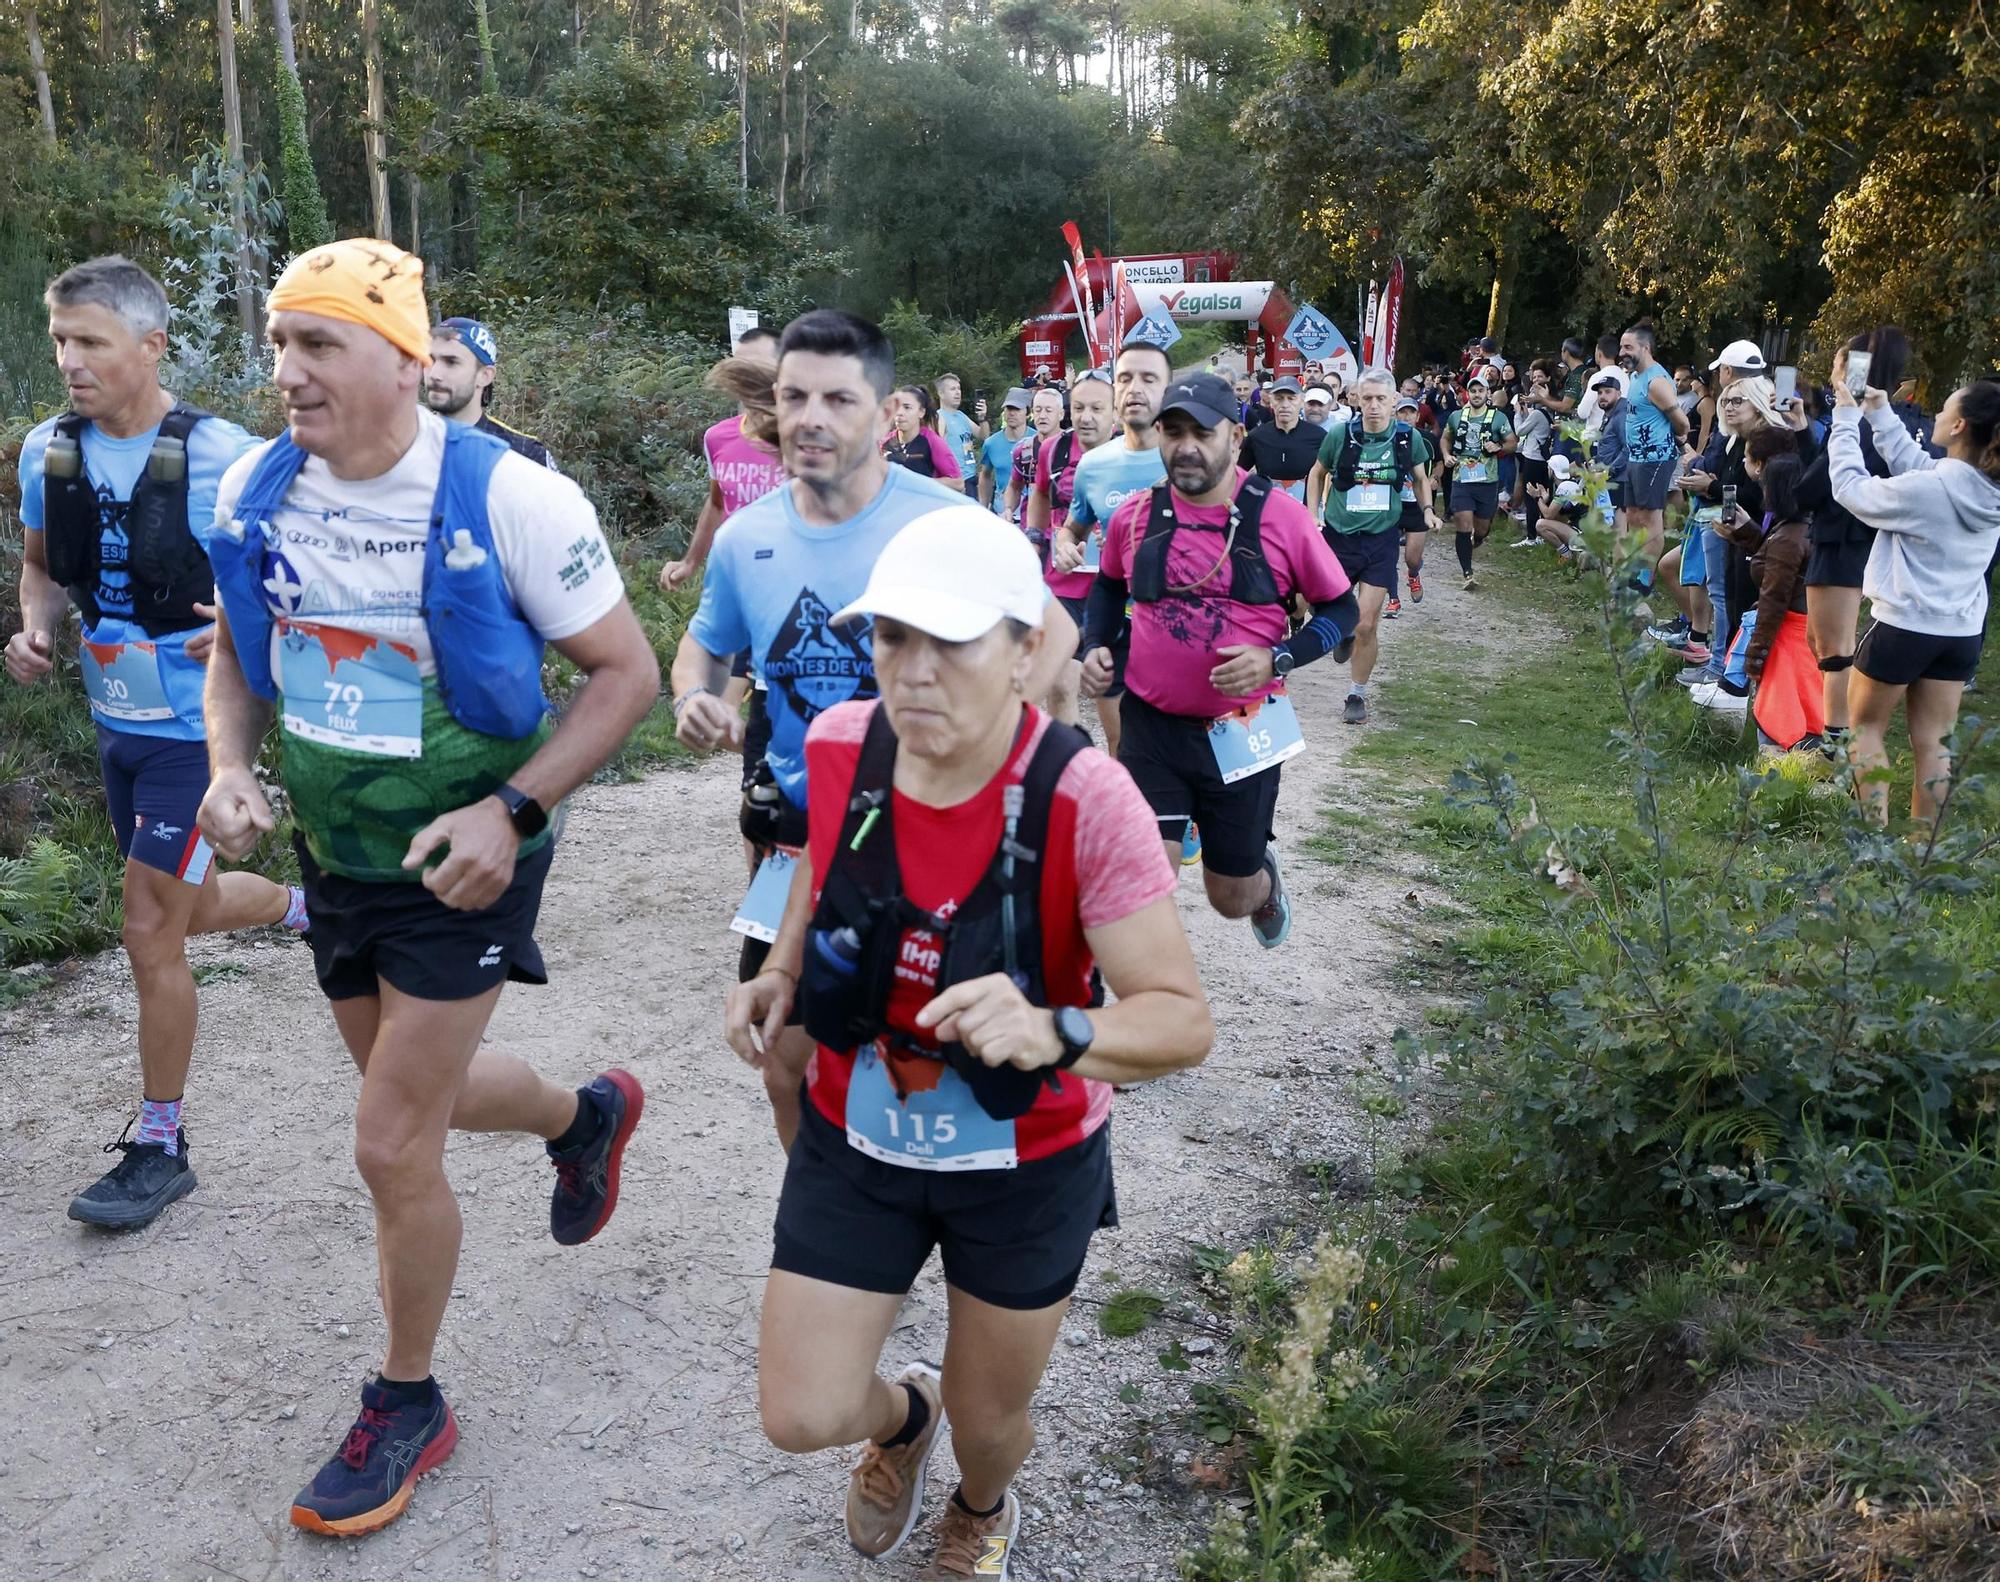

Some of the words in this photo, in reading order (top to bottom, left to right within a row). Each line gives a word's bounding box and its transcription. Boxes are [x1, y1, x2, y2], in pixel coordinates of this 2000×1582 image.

[1125, 265, 1179, 277] ONCELLO
[1159, 290, 1242, 315] Vegalsa
[716, 462, 771, 483] HAPPY
[828, 659, 851, 675] DE
[103, 678, 129, 699] 30
[323, 680, 364, 717] 79
[1247, 728, 1272, 754] 85
[884, 1107, 958, 1144] 115
[905, 1141, 935, 1156] Deli
